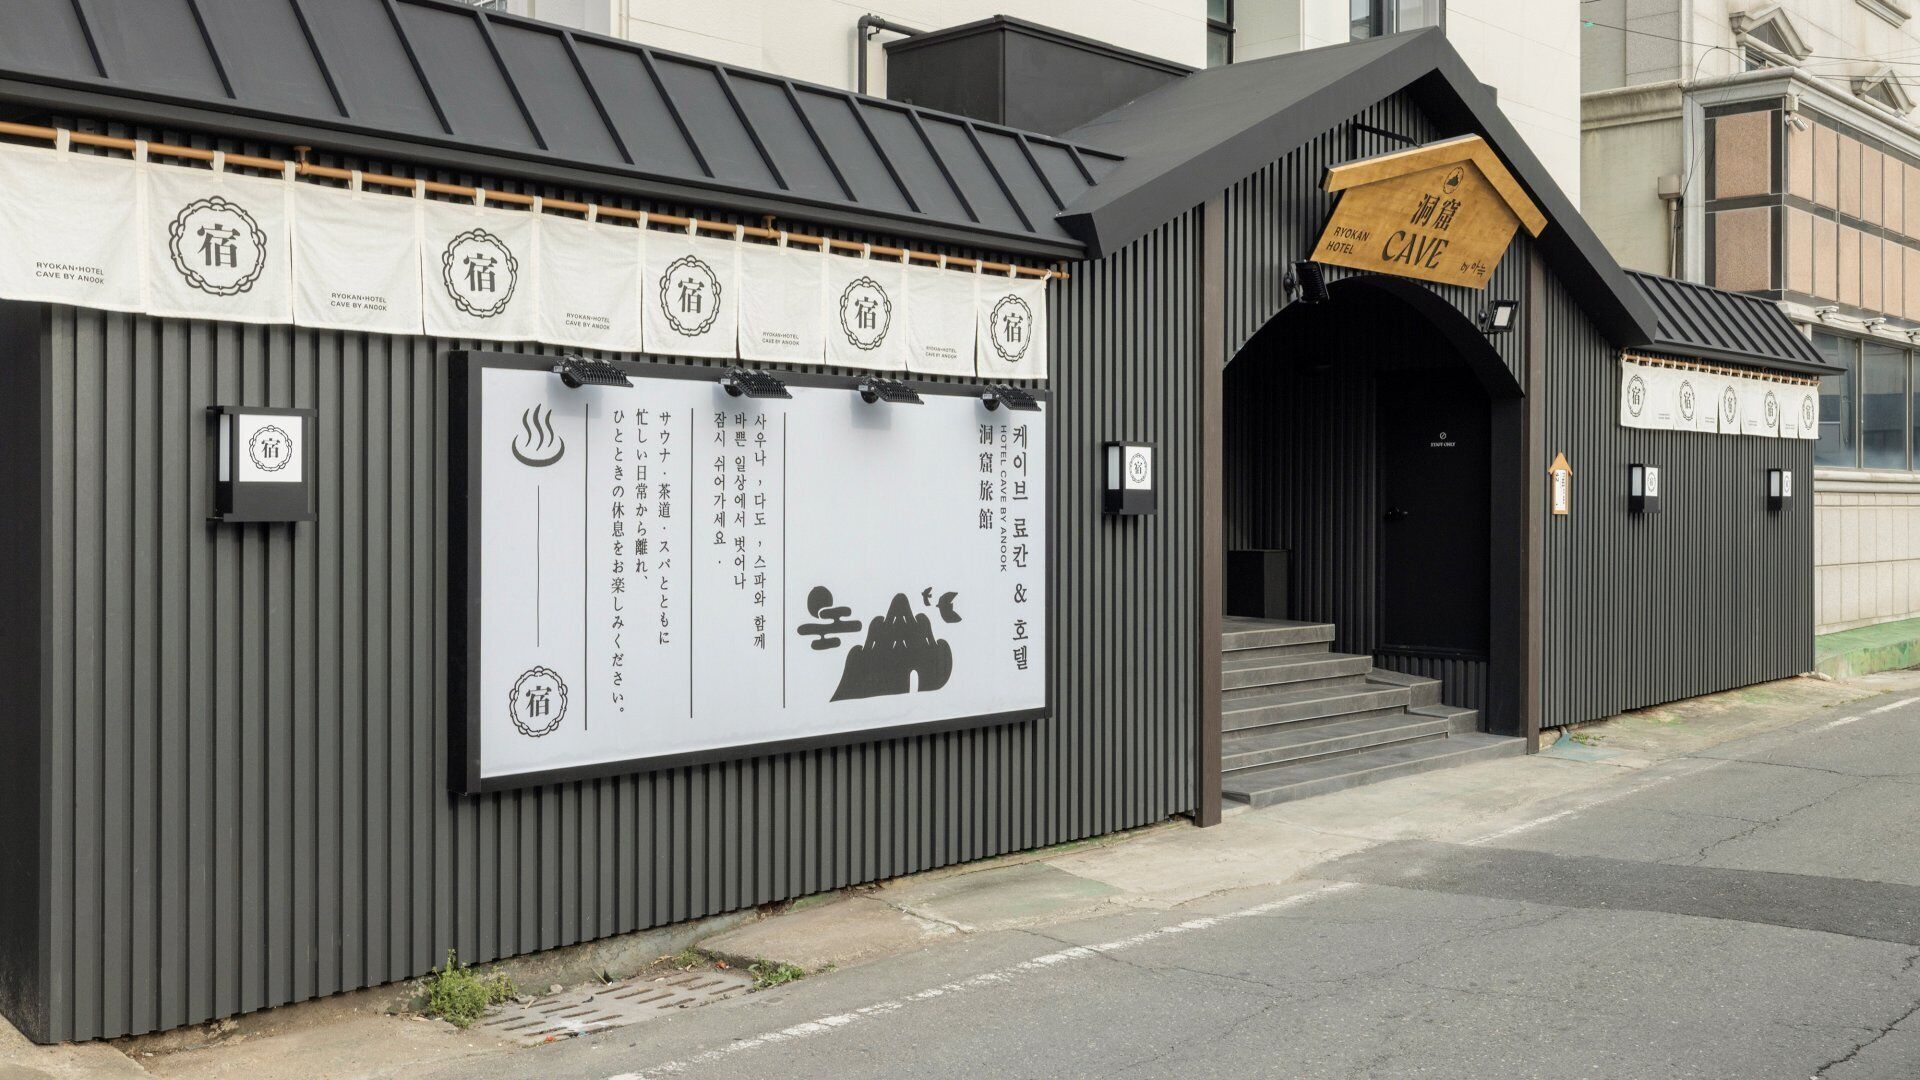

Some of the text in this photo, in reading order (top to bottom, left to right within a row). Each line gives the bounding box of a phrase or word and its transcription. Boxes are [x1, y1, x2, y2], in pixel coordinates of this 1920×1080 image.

[1410, 193, 1461, 231] 洞窟
[197, 223, 240, 268] 宿
[1326, 241, 1353, 255] HOTEL
[1333, 226, 1370, 242] RYOKAN
[1382, 230, 1449, 268] CAVE
[35, 270, 61, 279] CAVE
[78, 274, 104, 284] ANOOK
[463, 252, 498, 293] 宿
[1460, 261, 1469, 271] by
[330, 300, 351, 308] CAVE
[364, 303, 387, 311] ANOOK
[677, 277, 705, 314] 宿
[855, 296, 878, 329] 宿
[565, 319, 581, 327] CAVE
[1003, 313, 1023, 343] 宿
[714, 411, 726, 447] 잠시
[261, 438, 281, 458] 宿
[635, 408, 648, 580] 忙しい日常から離れ、
[979, 424, 994, 530] 洞窟旅館
[734, 411, 747, 590] 바쁜 일상에서 벗어나
[1000, 507, 1007, 522] BY
[611, 410, 625, 712] ひとときの休息をお楽しみください。
[1013, 424, 1028, 670] 케이브 료칸 & 호텔
[754, 555, 767, 607] 스파와
[754, 614, 766, 650] 함께
[525, 685, 552, 718] 宿
